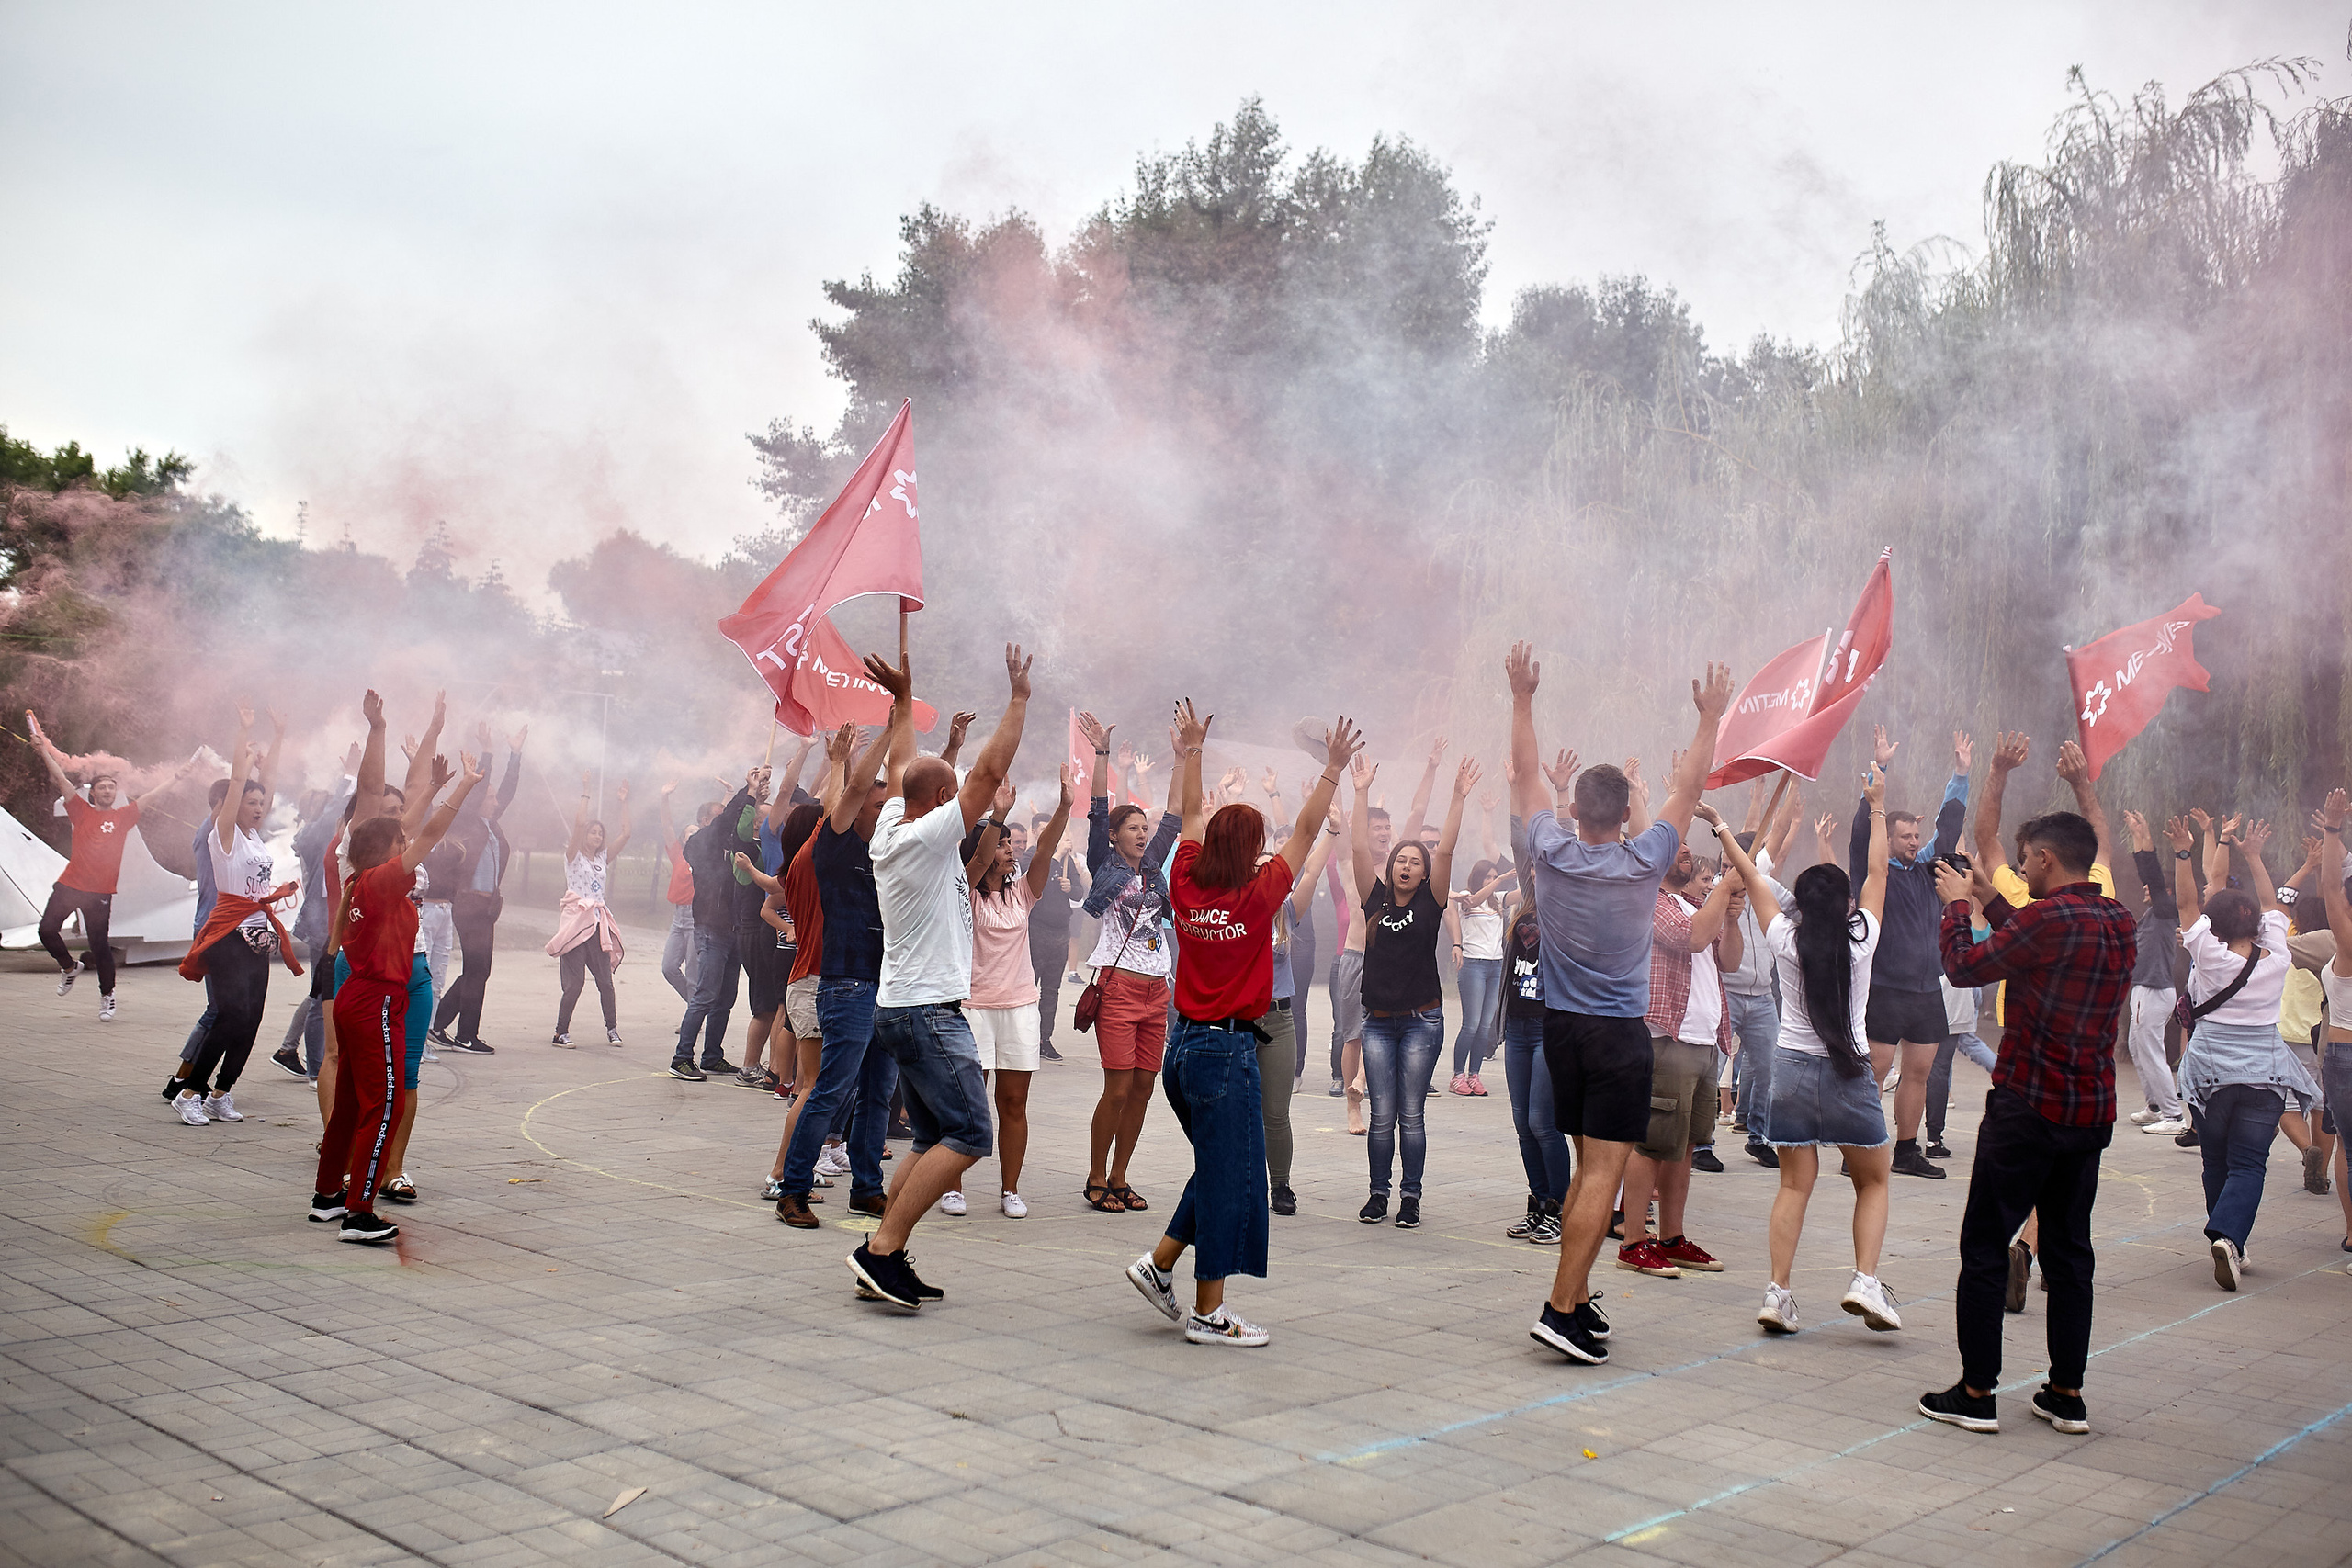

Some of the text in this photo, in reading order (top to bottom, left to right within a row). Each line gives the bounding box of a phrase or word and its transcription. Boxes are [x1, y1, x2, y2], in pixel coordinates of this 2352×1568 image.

[382, 1010, 390, 1043] adidas
[386, 1066, 395, 1100] adidas
[372, 1122, 387, 1158] adidas
